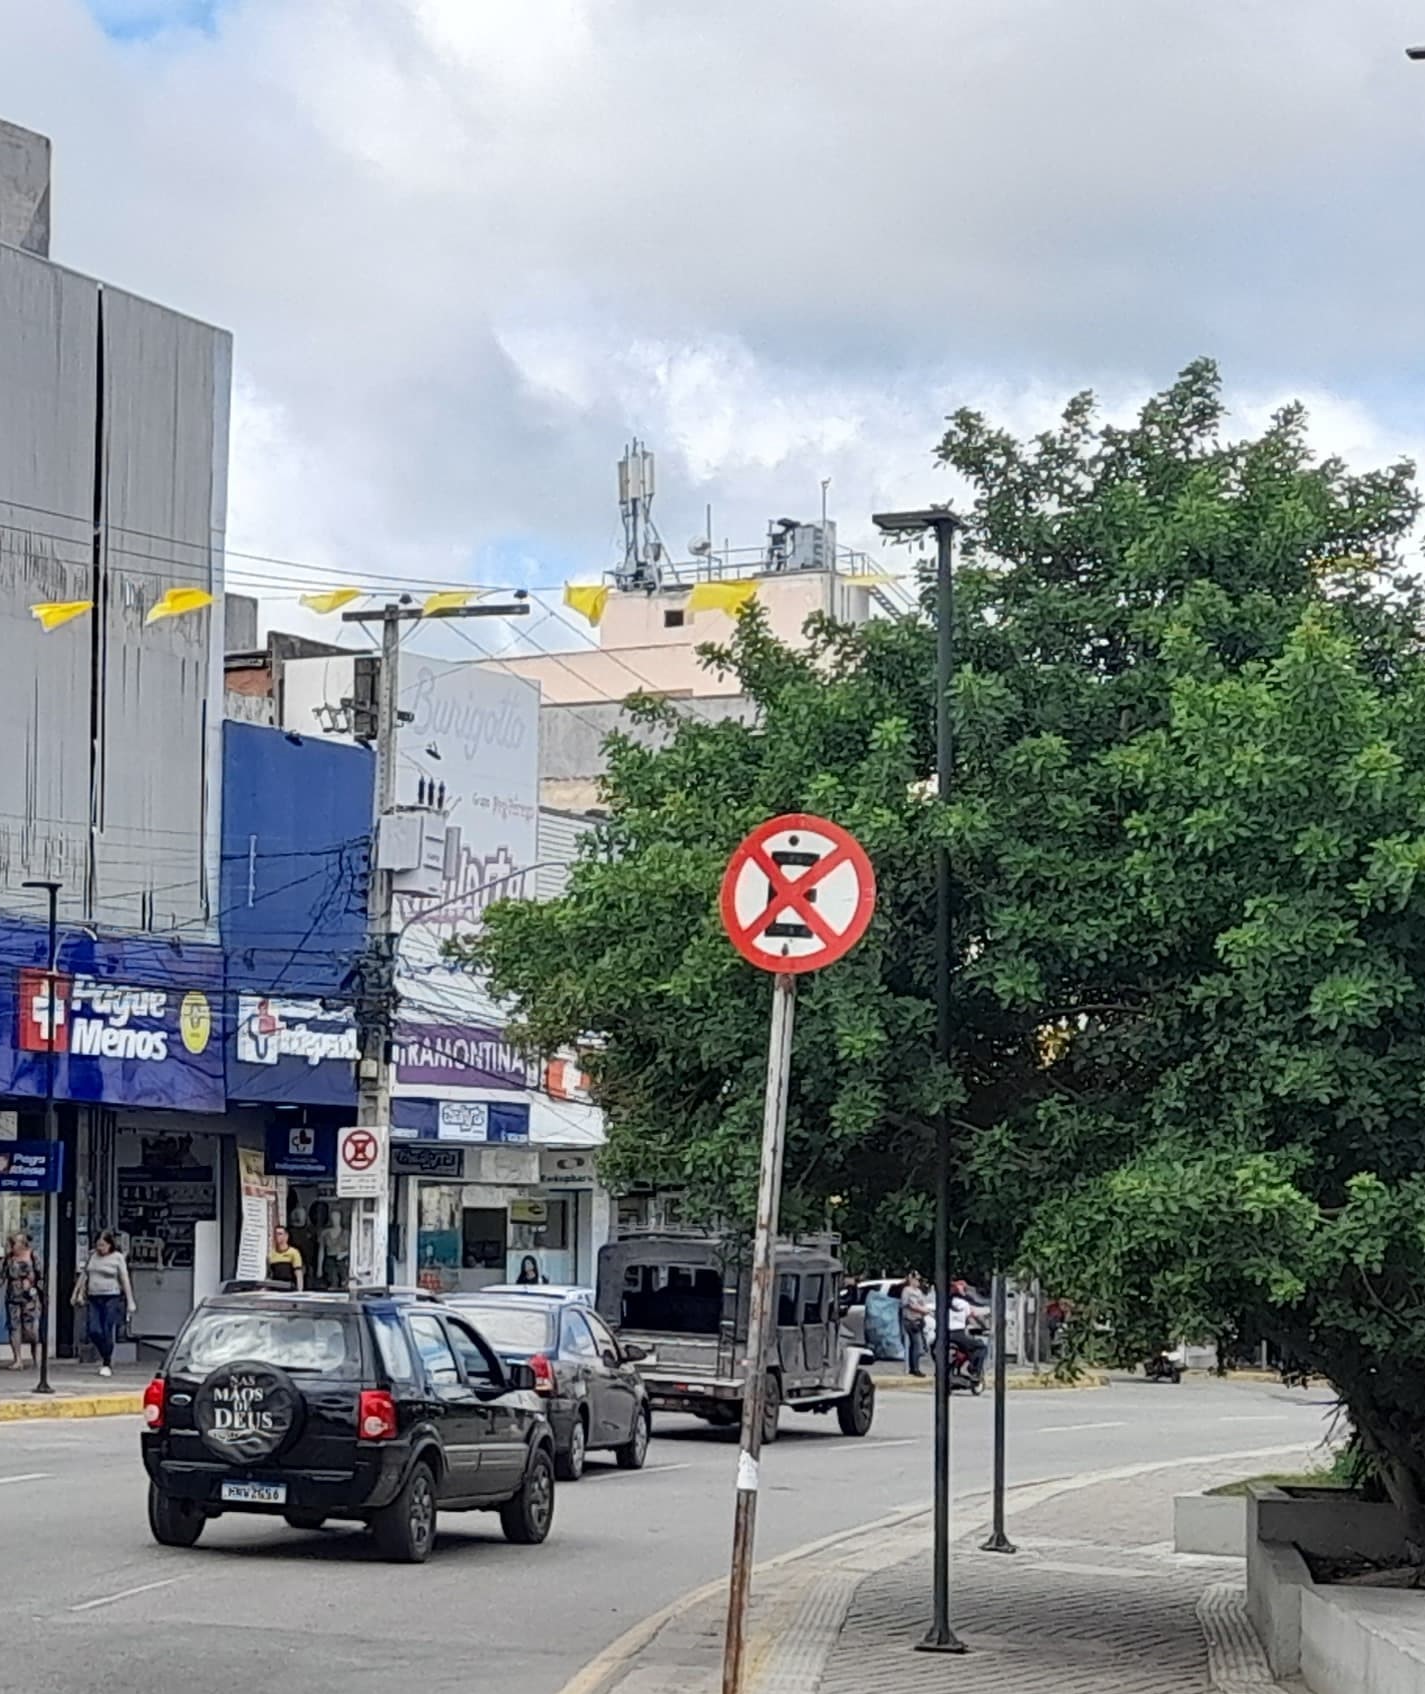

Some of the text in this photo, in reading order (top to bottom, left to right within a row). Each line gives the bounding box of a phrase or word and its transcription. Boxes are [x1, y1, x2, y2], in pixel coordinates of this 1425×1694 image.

[71, 974, 167, 1026] Pague
[71, 1017, 168, 1060] Menos
[230, 1375, 256, 1387] NAS
[214, 1407, 274, 1430] DEUS
